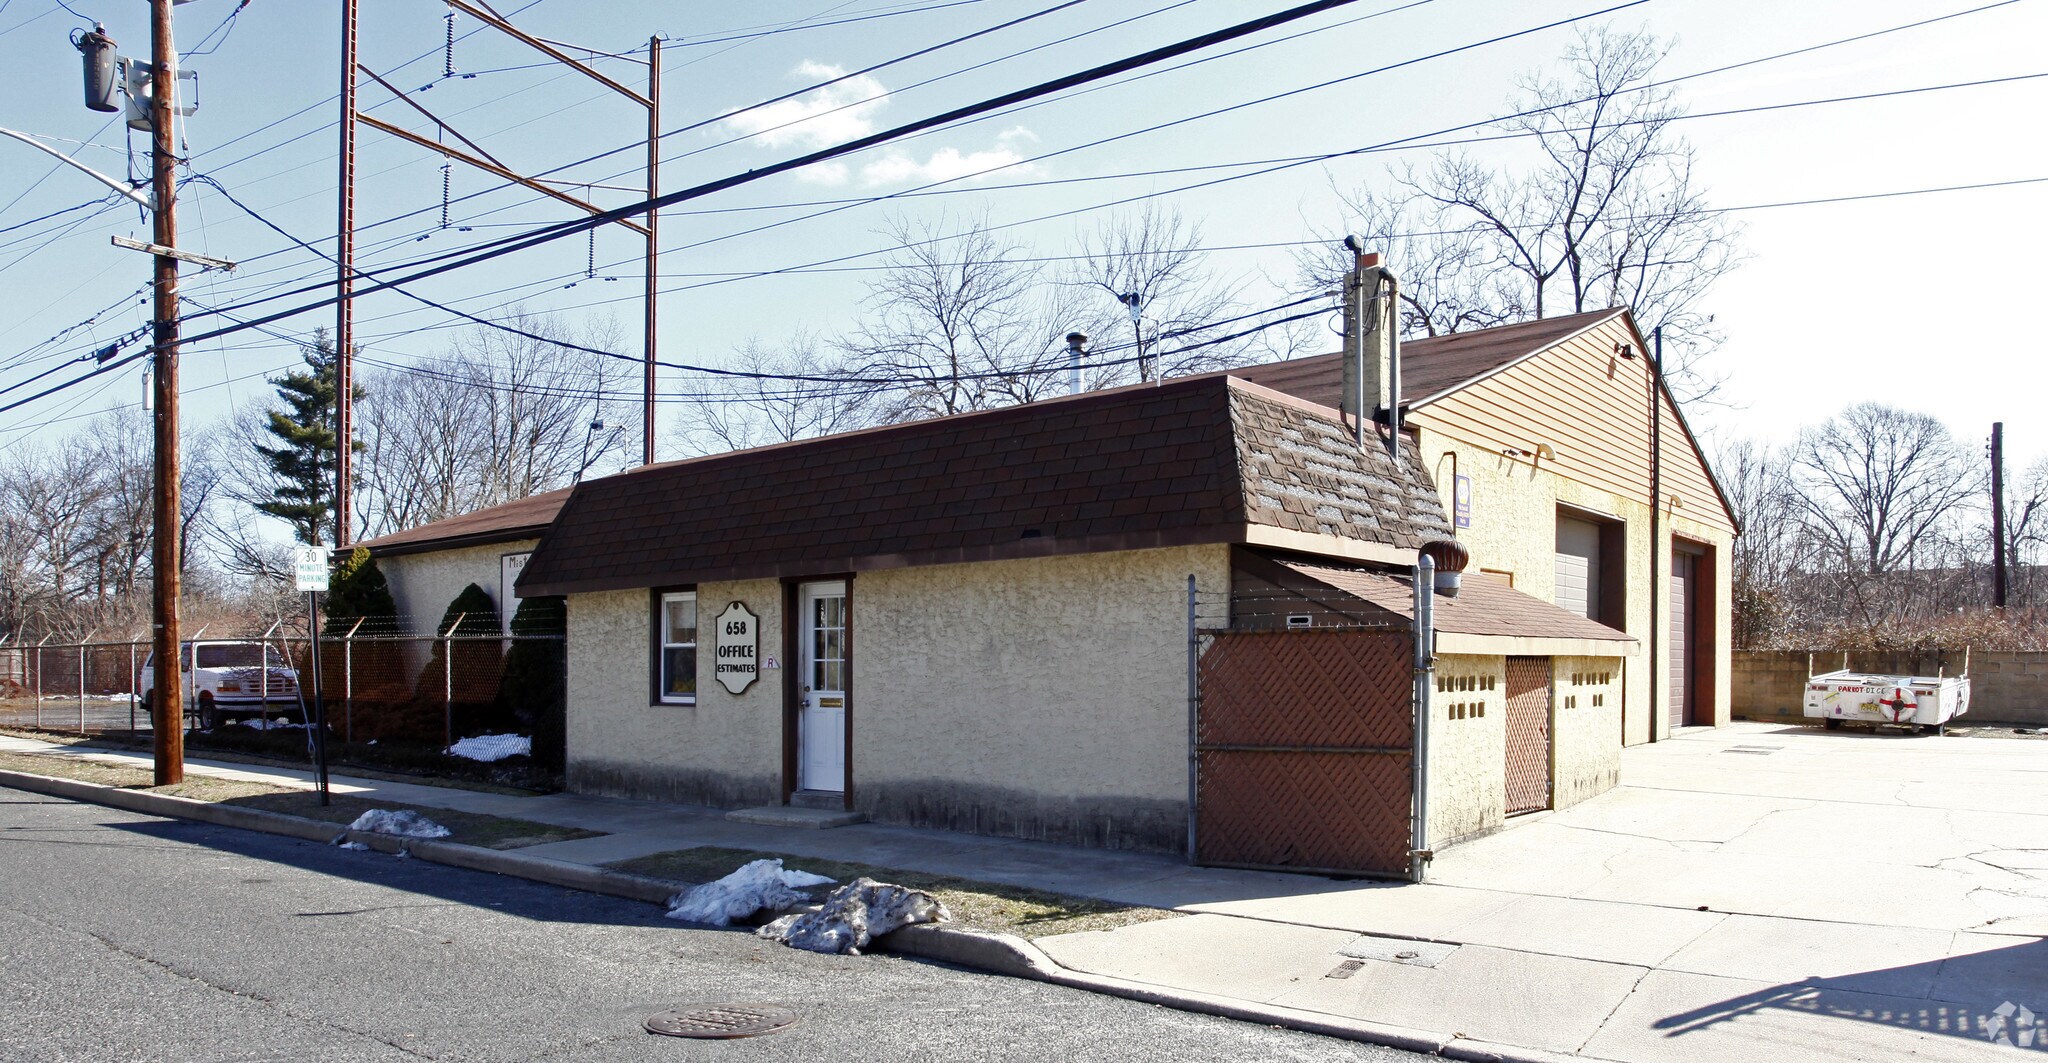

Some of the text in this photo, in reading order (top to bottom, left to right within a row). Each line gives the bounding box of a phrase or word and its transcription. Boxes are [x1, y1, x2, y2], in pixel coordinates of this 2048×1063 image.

[306, 552, 316, 562] 30
[300, 564, 323, 572] MINUTE
[299, 575, 325, 583] PARKING
[726, 621, 747, 635] 658
[718, 645, 754, 658] OFFICE
[767, 657, 774, 668] R
[717, 664, 756, 673] ESTIMATES
